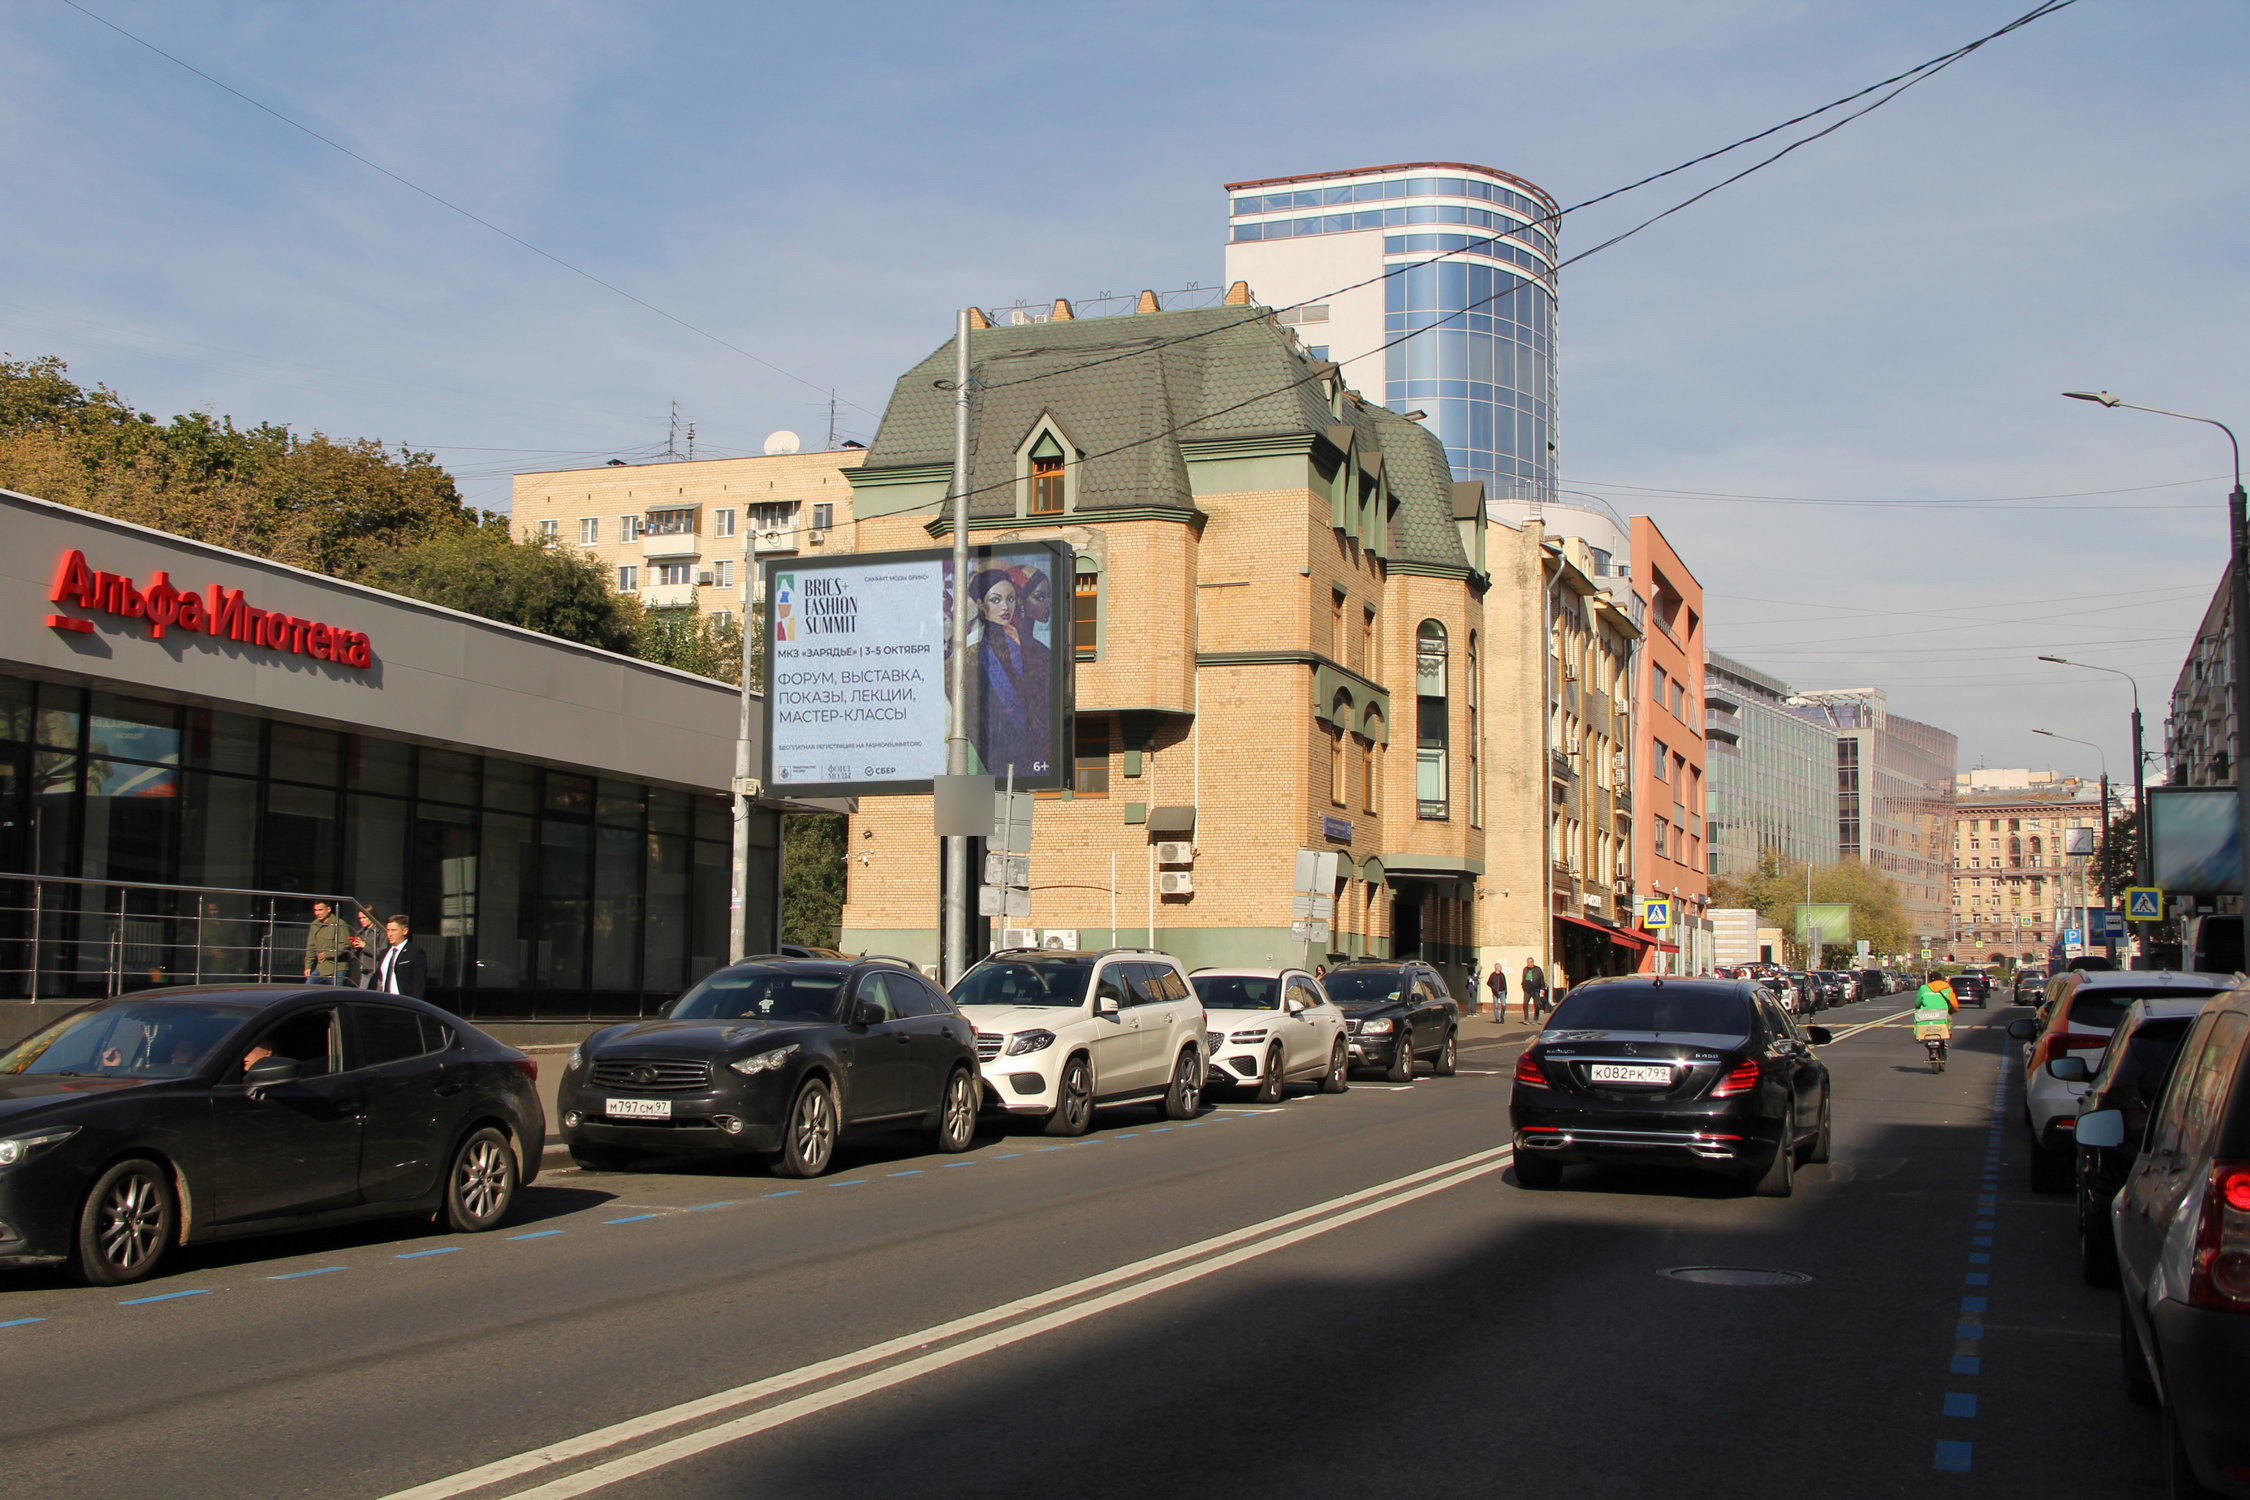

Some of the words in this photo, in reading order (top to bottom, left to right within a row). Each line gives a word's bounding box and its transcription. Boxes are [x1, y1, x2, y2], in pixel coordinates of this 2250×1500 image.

[804, 577, 850, 597] BRICS+
[50, 549, 205, 639] Альфа
[209, 584, 372, 669] Ипотека
[804, 596, 858, 616] FASHION
[805, 614, 858, 635] SUMMIT
[777, 649, 799, 658] МКЗ
[801, 647, 857, 658] «ЗАРЯДЬЕ»
[883, 644, 931, 655] ОКТЯБРЯ
[777, 671, 838, 686] ФОРУМ,
[841, 668, 925, 684] ВЫСТАВКА,
[778, 690, 847, 705] ПОКАЗЫ,
[850, 687, 917, 703] ЛЕКЦИИ,
[779, 707, 907, 724] МАСТЕР-КЛАССЫ
[875, 766, 897, 775] СБЕР
[1033, 761, 1050, 771] 6+
[1647, 1067, 1668, 1077] 799
[655, 1102, 667, 1111] 97
